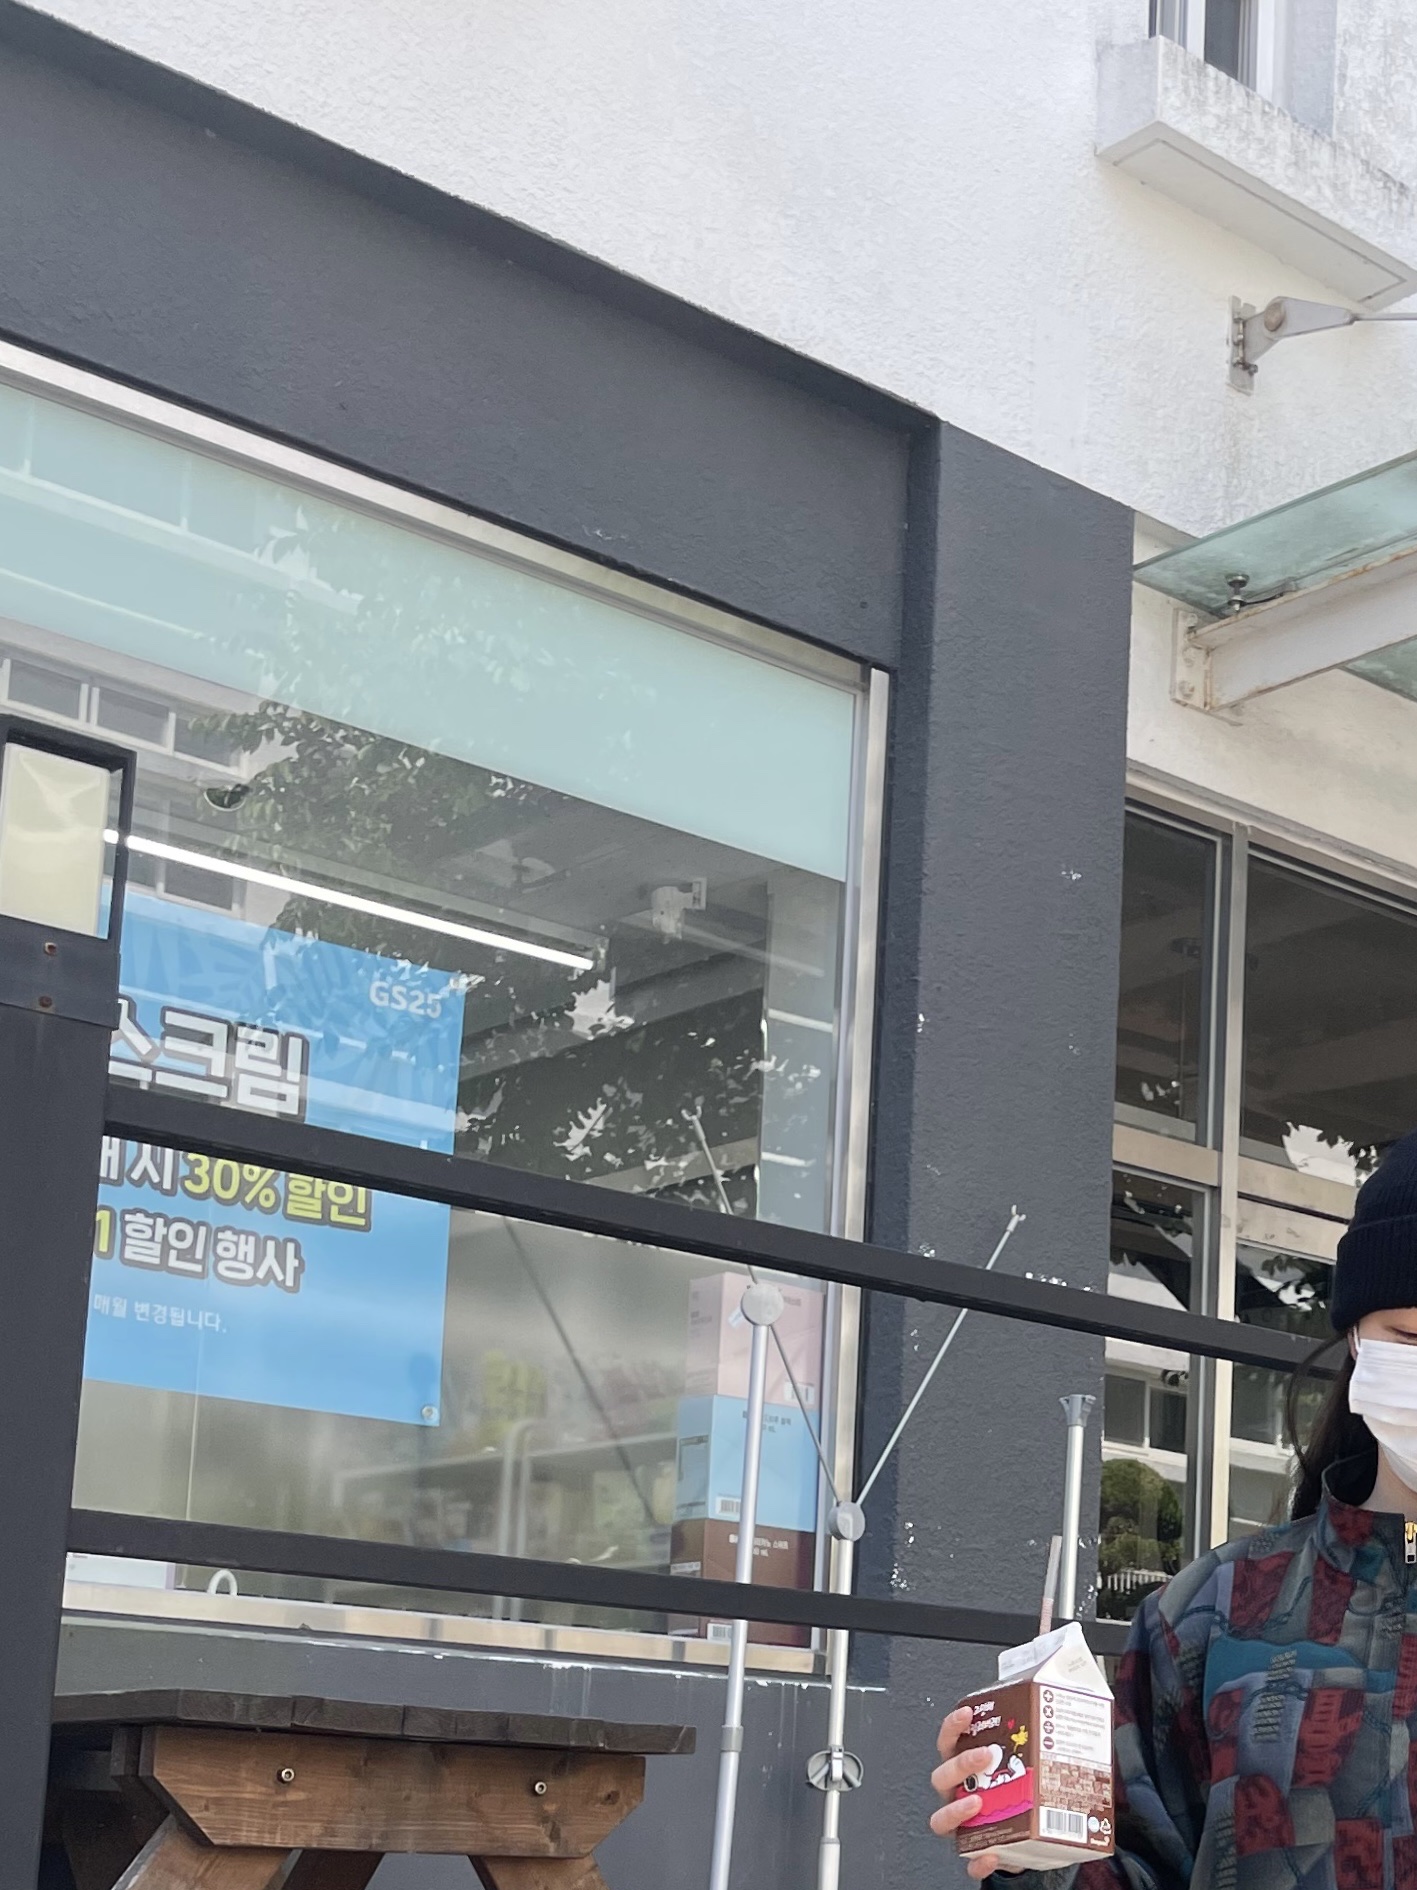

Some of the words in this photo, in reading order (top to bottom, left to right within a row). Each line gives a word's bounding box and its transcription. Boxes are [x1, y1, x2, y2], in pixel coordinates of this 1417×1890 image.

[369, 980, 442, 1019] GS25
[184, 1152, 276, 1208] 30%
[286, 1173, 366, 1226] 할인
[124, 1212, 207, 1273] 할인
[215, 1229, 299, 1287] 행사
[94, 1293, 127, 1319] 매월
[133, 1300, 227, 1333] 변경됩니다.
